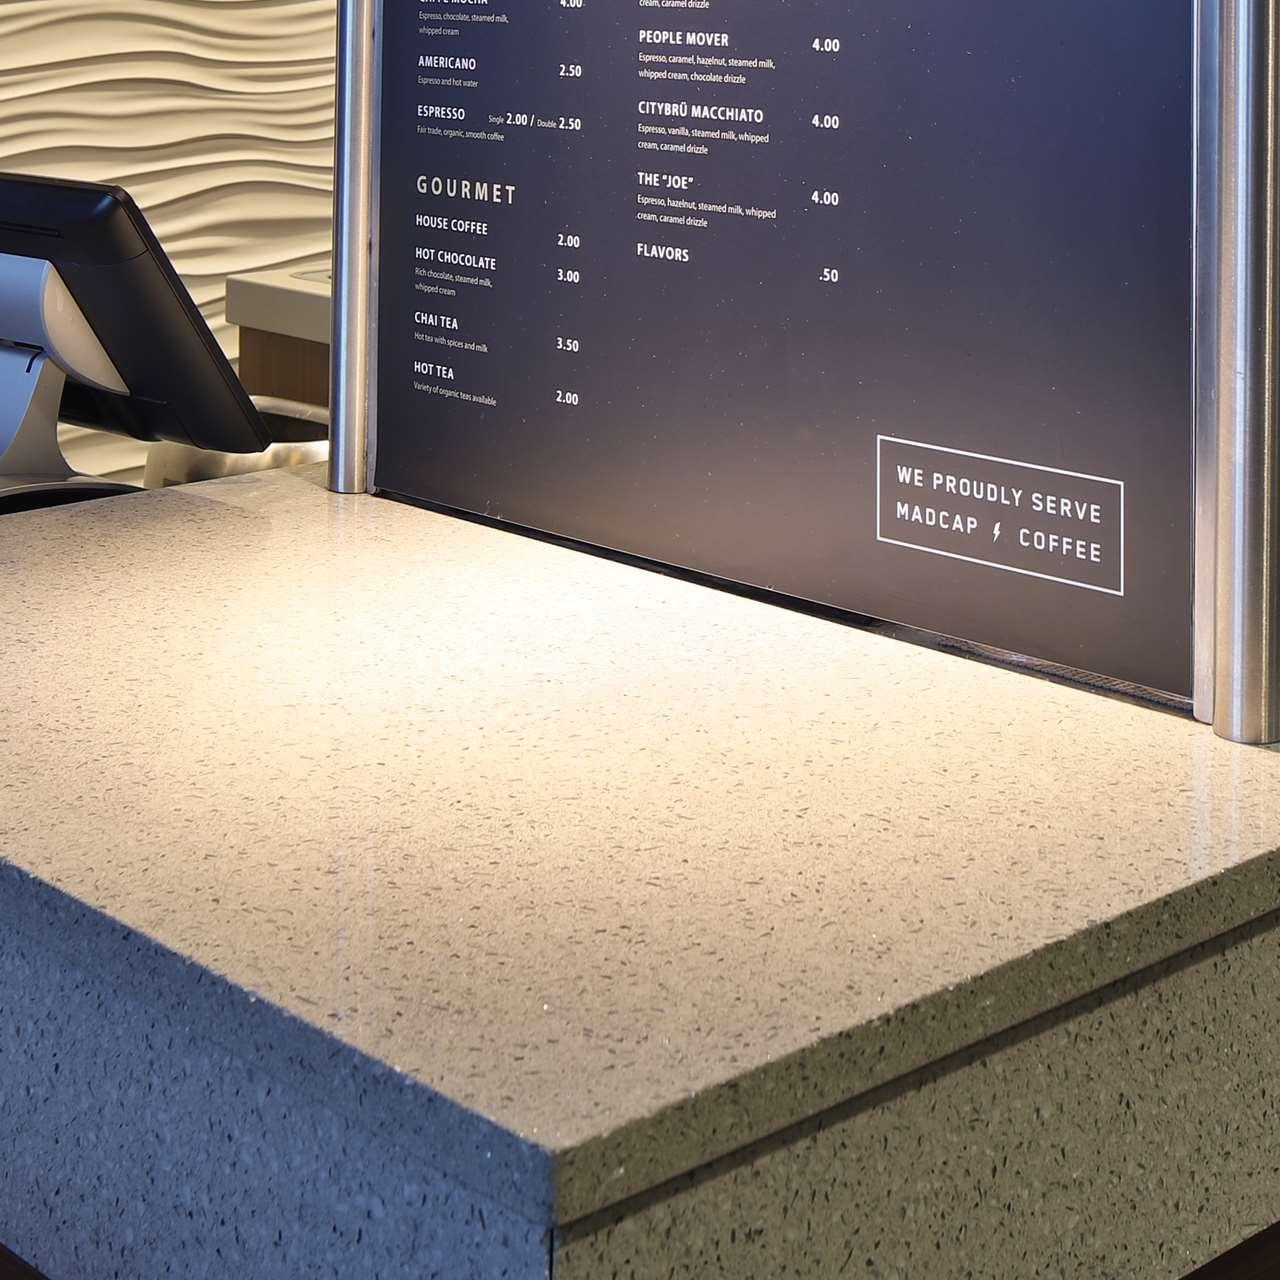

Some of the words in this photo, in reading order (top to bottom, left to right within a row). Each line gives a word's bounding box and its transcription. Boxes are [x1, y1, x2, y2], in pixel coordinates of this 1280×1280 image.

[662, 0, 687, 7] caramel
[688, 0, 709, 8] drizzle
[640, 30, 682, 44] PEOPLE
[686, 32, 728, 46] MOVER
[812, 39, 840, 51] 4.00
[419, 56, 476, 69] AMERICANO
[560, 64, 581, 76] 2.50
[639, 52, 667, 63] Espresso,
[669, 55, 695, 64] caramel,
[697, 56, 727, 67] hazelnut,
[729, 59, 757, 67] steamed
[759, 59, 775, 69] milk,
[639, 69, 666, 79] whipped
[668, 72, 689, 80] cream,
[691, 72, 723, 82] chocolate
[722, 74, 745, 83] drizzle
[418, 105, 465, 120] ESPRESSO
[506, 113, 528, 125] 2.00
[559, 118, 581, 130] 2.50
[691, 105, 763, 122] MACCHIATO
[812, 115, 839, 128] 4.00
[638, 124, 666, 134] Espresso,
[668, 127, 690, 136] vanilla,
[692, 129, 720, 138] steamed
[721, 131, 737, 141] milk,
[739, 132, 769, 144] whipped
[638, 142, 659, 150] cream,
[660, 144, 685, 152] caramel
[687, 144, 708, 154] drizzle
[417, 176, 515, 204] GOURMET
[638, 172, 659, 186] THE
[812, 191, 839, 205] 4.00
[638, 195, 666, 206] Espresso,
[668, 198, 697, 210] hazelnut,
[698, 203, 726, 212] steamed
[728, 205, 744, 216] milk,
[746, 207, 776, 219] whipped
[416, 215, 448, 229] HOUSE
[451, 220, 487, 235] COFFEE
[558, 234, 579, 247] 2.00
[637, 213, 658, 222] cream,
[660, 215, 685, 224] caramel
[686, 217, 707, 227] drizzle
[416, 248, 435, 260] HOT
[438, 251, 495, 270] CHOCOLATE
[558, 269, 579, 283] 3.00
[638, 243, 689, 261] FLAVORS
[820, 268, 838, 282] .50
[415, 312, 437, 325] CHAI
[440, 316, 458, 329] TEA
[557, 337, 578, 352] 3.50
[415, 361, 433, 375] HOT
[436, 366, 453, 379] TEA
[556, 391, 578, 405] 2.00
[897, 465, 923, 487] WE
[933, 472, 1022, 507] PROUDLY
[1032, 492, 1101, 524] SERVE
[896, 501, 978, 534] MADCAP
[1019, 528, 1101, 563] COFFEE
